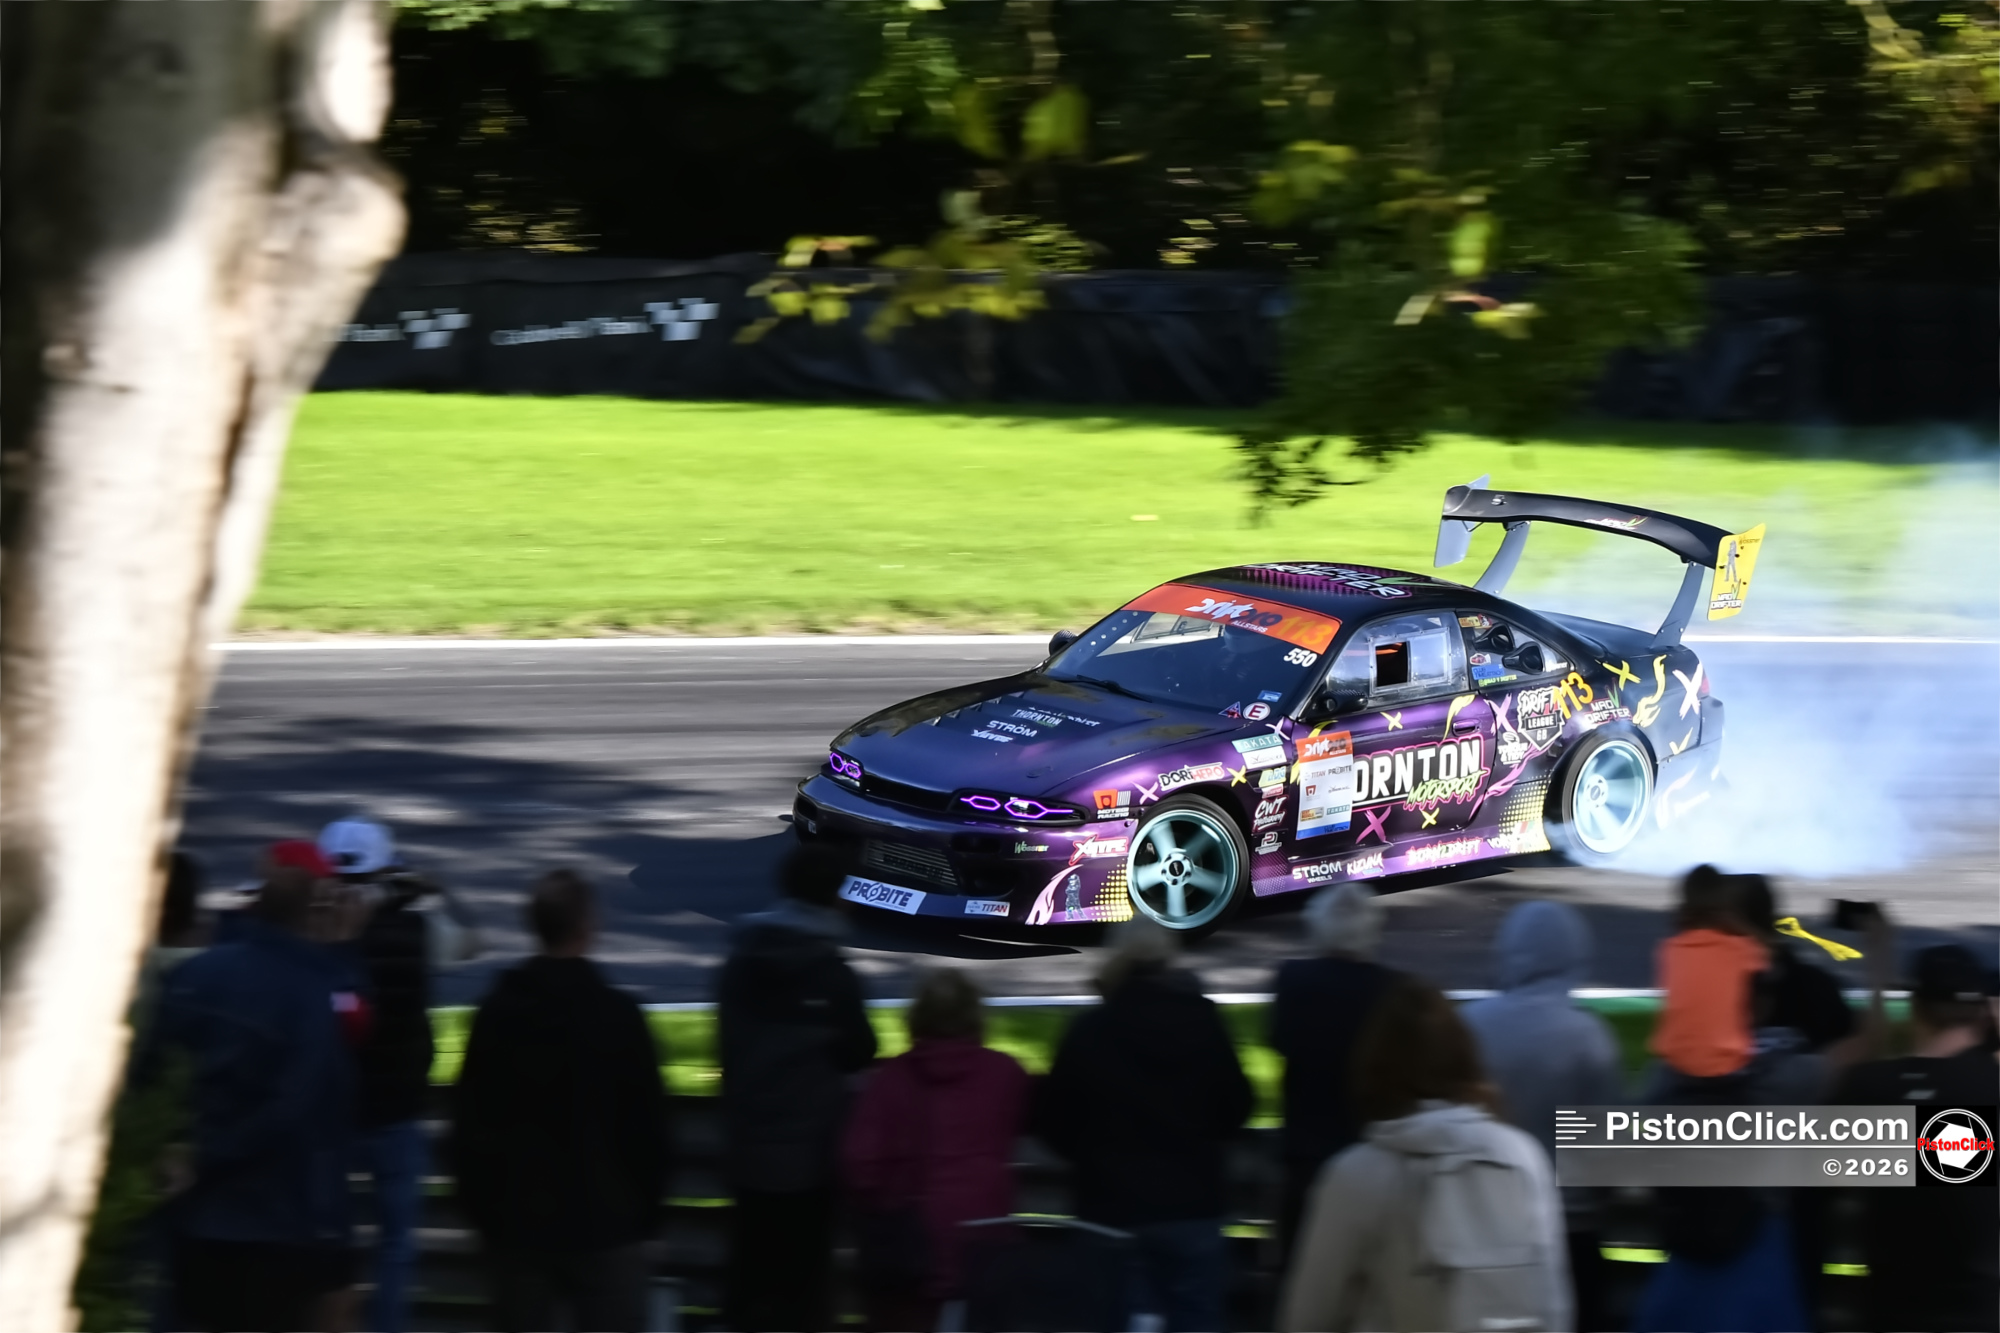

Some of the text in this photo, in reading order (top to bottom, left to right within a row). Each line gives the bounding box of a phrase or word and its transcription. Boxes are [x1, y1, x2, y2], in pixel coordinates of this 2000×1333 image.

[1231, 619, 1269, 633] ALLSTARS
[1276, 616, 1333, 646] 113
[1283, 648, 1318, 668] 550
[1551, 672, 1593, 719] 113
[1248, 705, 1265, 718] E
[1590, 700, 1614, 711] MAD
[1011, 709, 1063, 725] THORNTON
[1528, 715, 1554, 728] LEAGUE
[1584, 708, 1632, 723] DRIFTER
[987, 720, 1038, 738] STRÖM
[1353, 739, 1480, 801] ORNTON
[1406, 769, 1488, 805] MOTORSPORT
[1255, 797, 1287, 818] CWT
[1292, 860, 1342, 880] STRÖM
[1307, 874, 1333, 884] WHEELS
[848, 880, 913, 907] PROBITE
[981, 903, 1008, 913] TITAN
